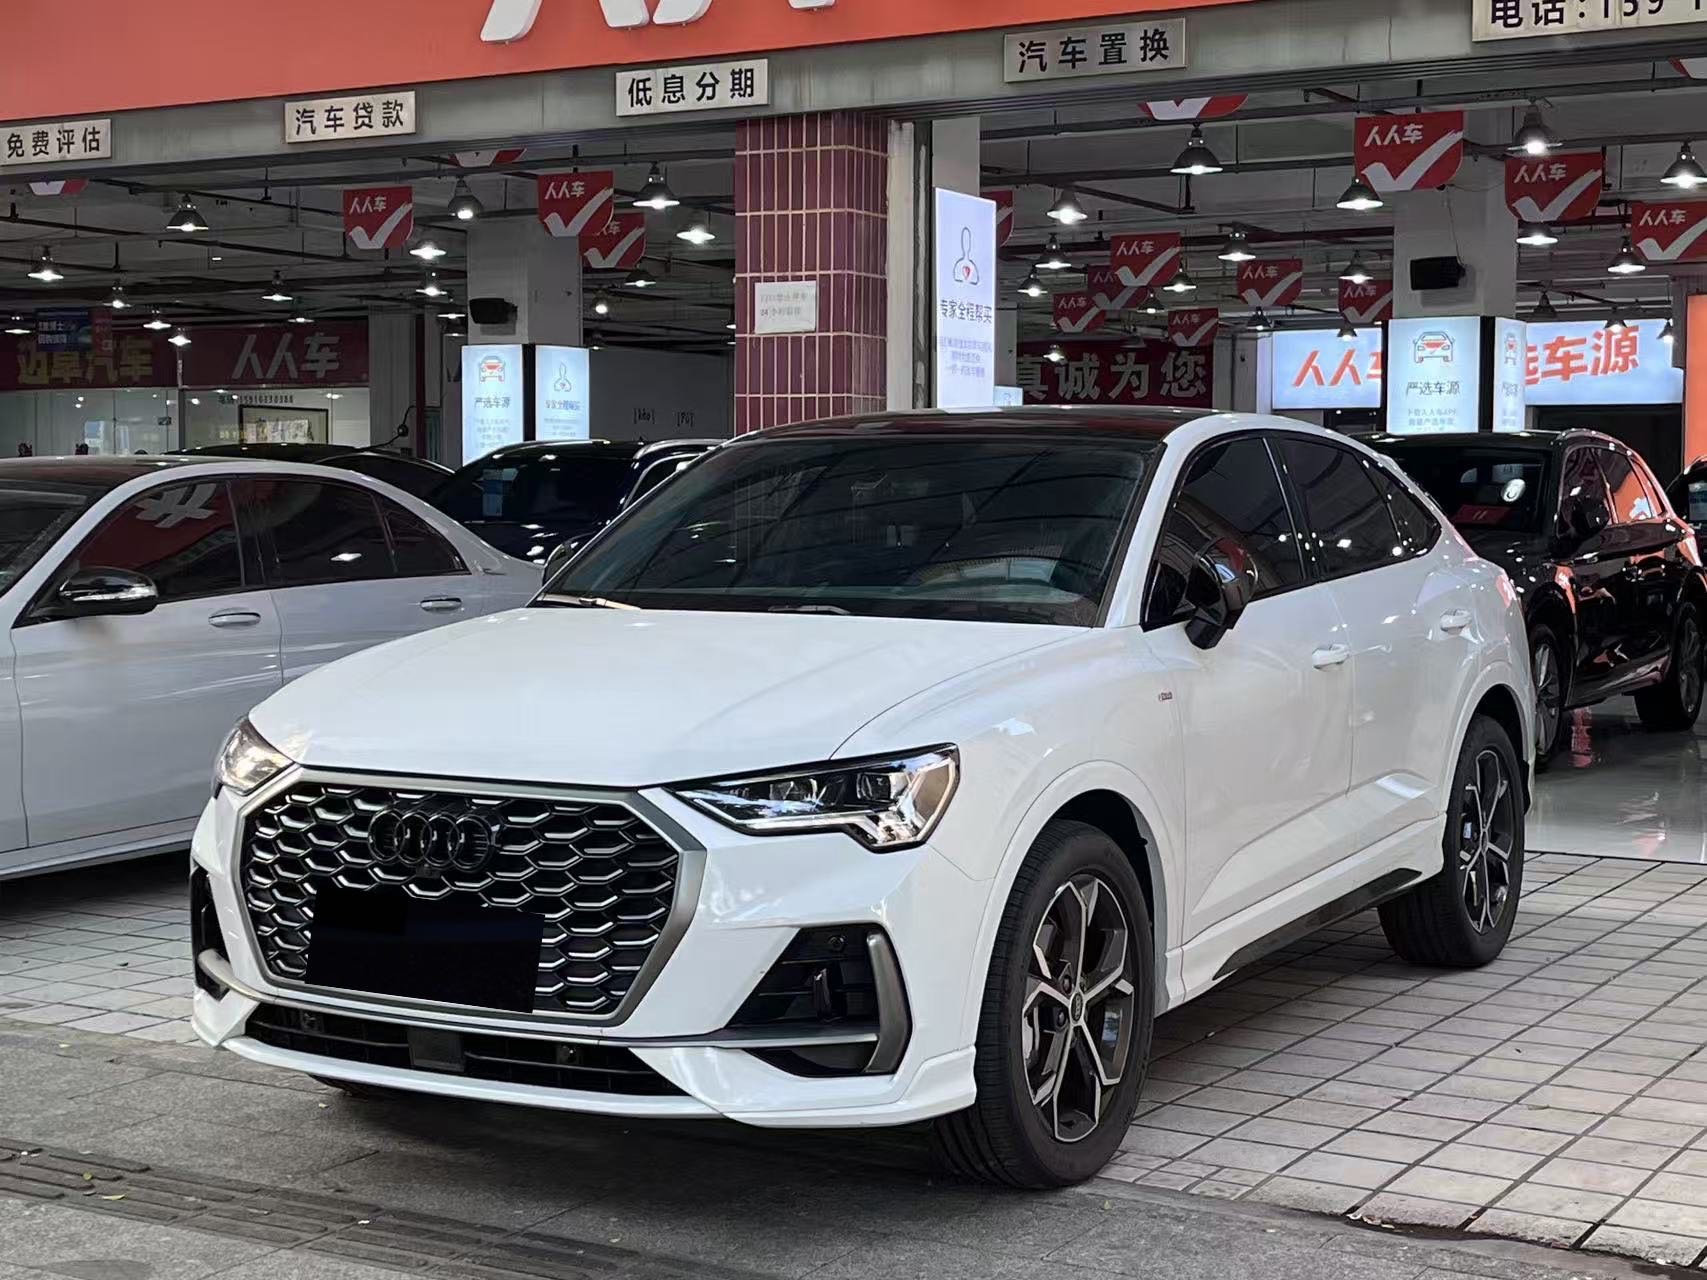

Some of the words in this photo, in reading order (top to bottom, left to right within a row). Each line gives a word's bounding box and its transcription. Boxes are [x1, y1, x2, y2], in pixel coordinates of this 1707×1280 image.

[1018, 29, 1169, 73] 汽车置换
[628, 68, 755, 107] 低息分期
[295, 100, 404, 136] 汽车贷款
[7, 126, 101, 158] 免费评估
[1364, 123, 1425, 147] 人人车
[1513, 162, 1568, 184] 人人车
[544, 180, 586, 199] 人人车
[348, 195, 387, 214] 人人车
[1639, 208, 1687, 226] 人人车
[1116, 239, 1155, 257] 人人车
[1243, 265, 1279, 280] 人人车
[1344, 285, 1377, 298] 人人车
[1058, 297, 1088, 309] 人人车
[1172, 313, 1200, 325] 人人车
[231, 331, 341, 380] 人人车
[1015, 351, 1208, 400] 真诚为您
[1406, 380, 1461, 396] 严选车源
